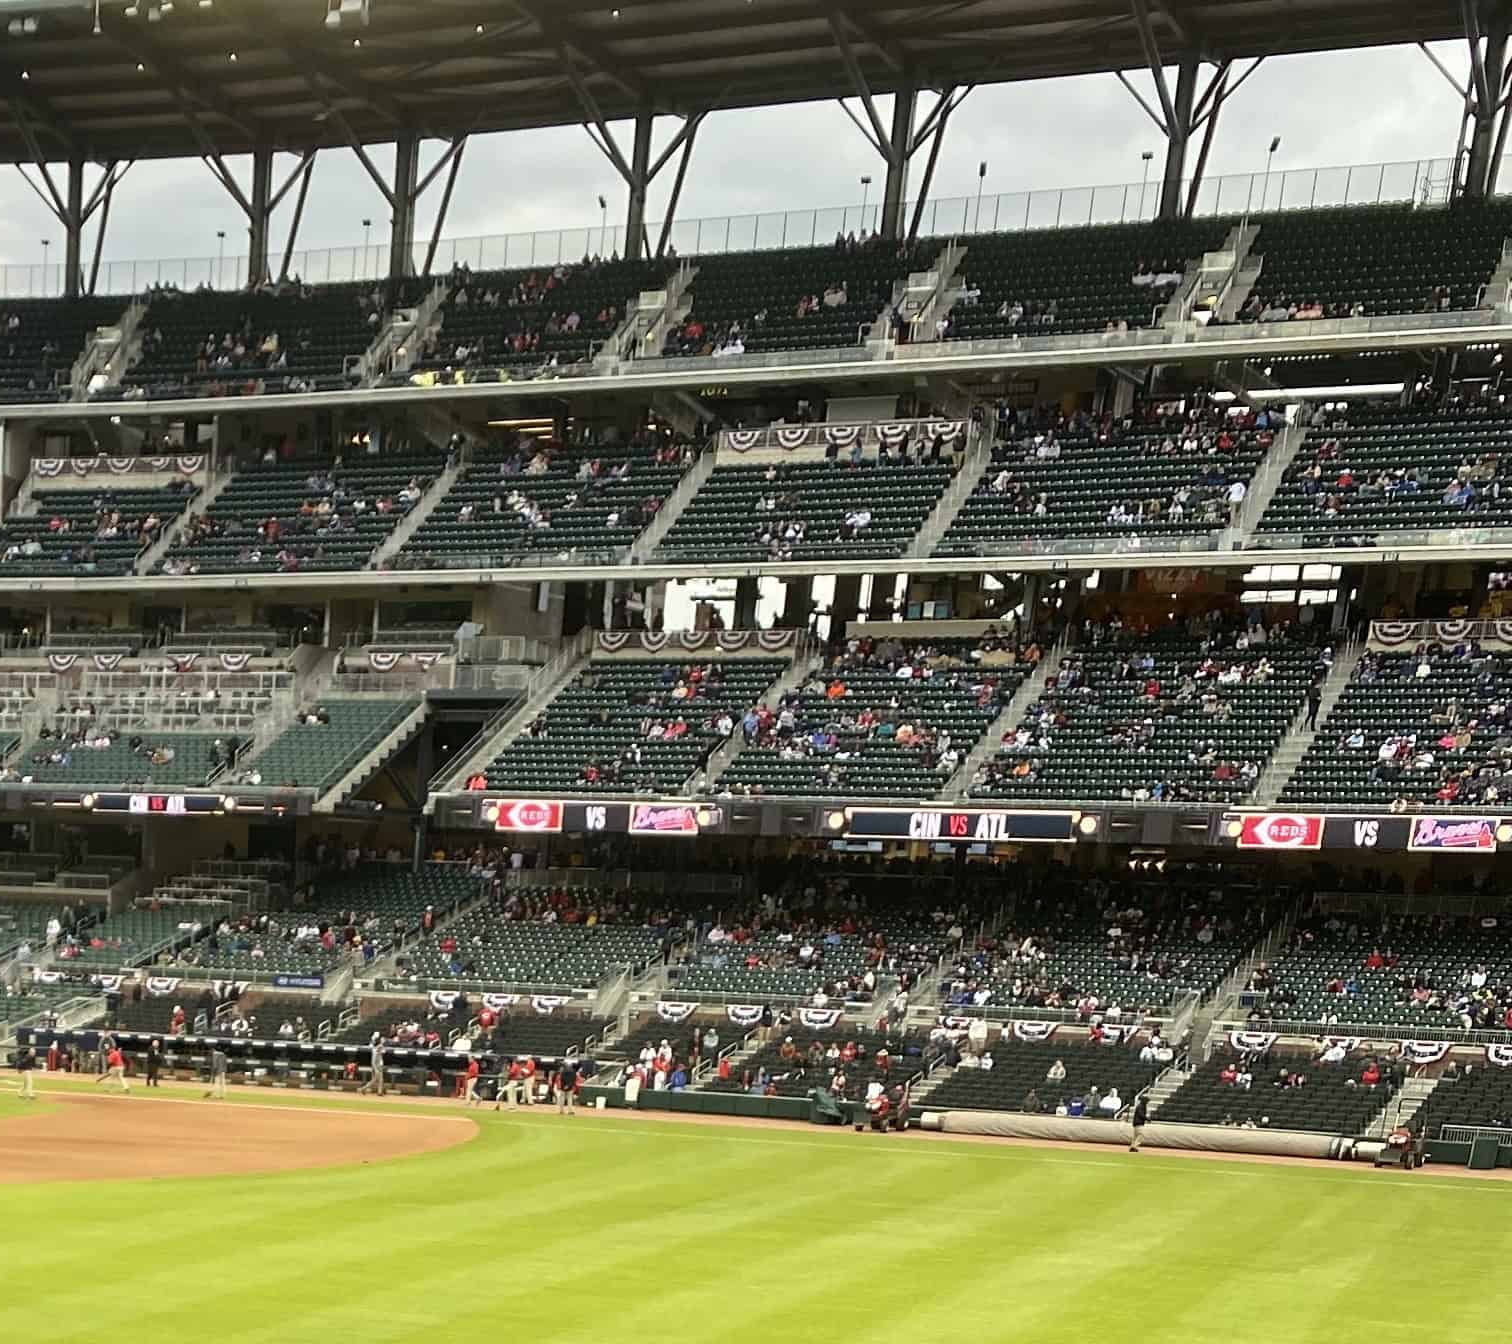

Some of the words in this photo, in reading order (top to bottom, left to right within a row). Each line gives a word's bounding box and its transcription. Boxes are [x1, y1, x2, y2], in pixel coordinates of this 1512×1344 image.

[520, 810, 553, 821] REDS
[585, 806, 607, 829] VS
[908, 813, 942, 838] CIN
[949, 815, 968, 835] VS
[975, 813, 1009, 839] ATL
[1269, 824, 1308, 837] REDS
[1354, 820, 1380, 847] VS
